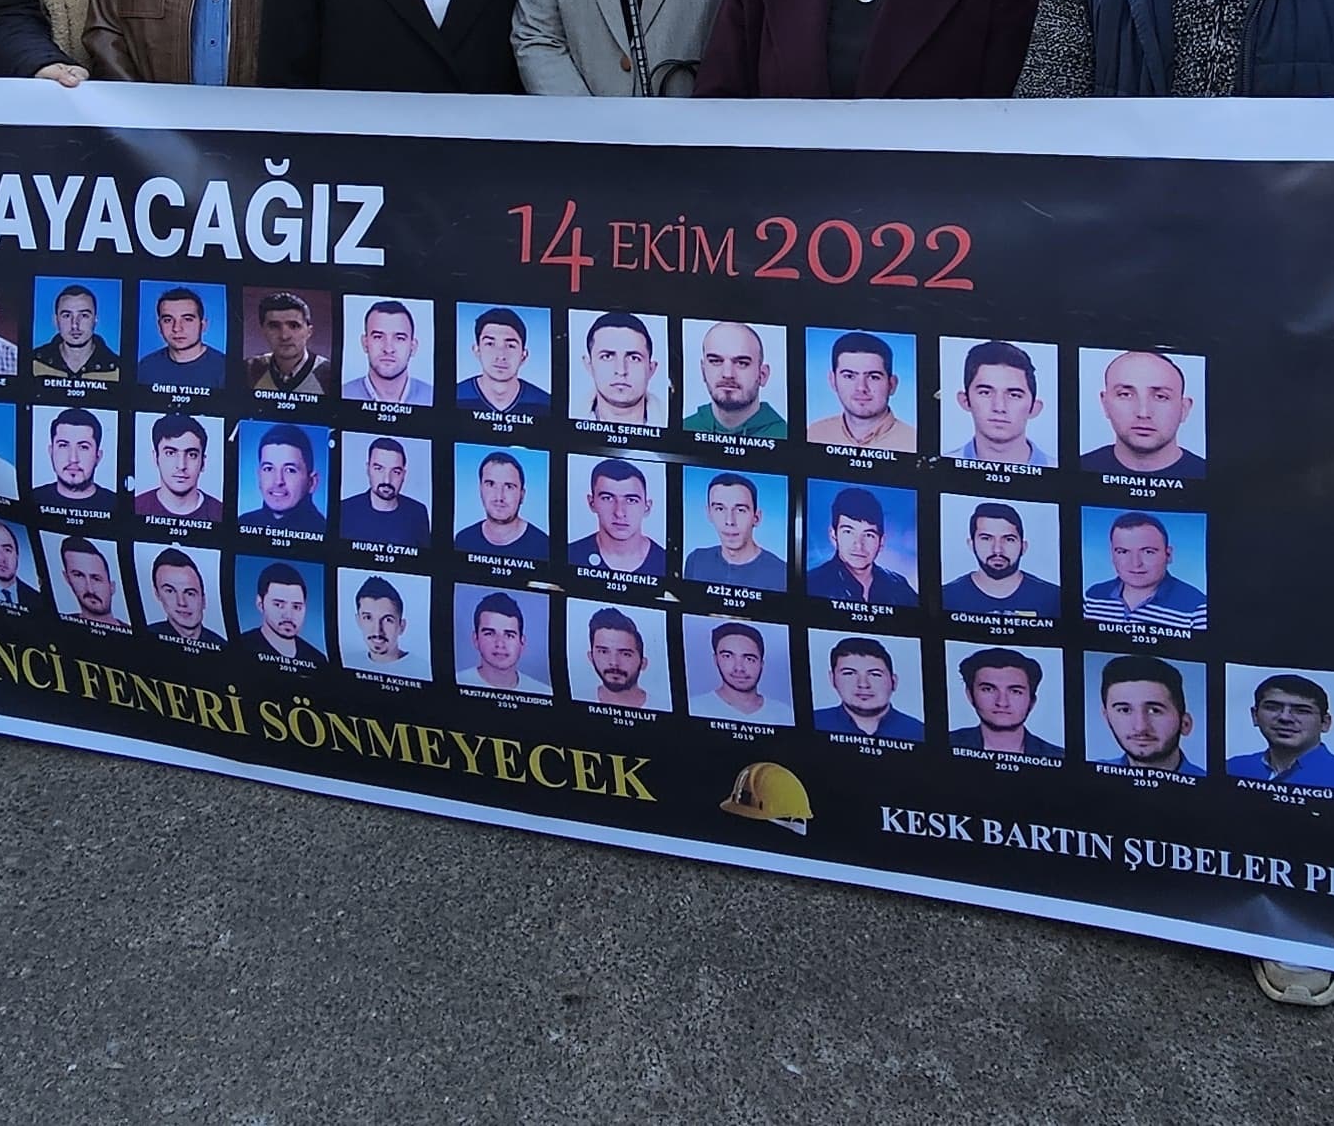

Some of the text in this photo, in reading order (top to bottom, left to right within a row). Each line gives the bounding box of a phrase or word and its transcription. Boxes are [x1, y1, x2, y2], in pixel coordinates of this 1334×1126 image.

[508, 200, 974, 293] 14 EKİM 2022
[44, 378, 108, 391] DENİZ BAYKAL
[151, 382, 210, 396] ÖNER YILDIZ
[67, 389, 86, 397] 2009
[255, 390, 318, 403] ORHAN ALTUN
[171, 395, 191, 404] 2009
[277, 402, 296, 411] 2009
[362, 402, 412, 415] ALİ DOĞRU
[377, 414, 396, 422] 2019
[472, 410, 534, 425] YASİN ÇELİK
[492, 424, 513, 433] 2019
[575, 420, 661, 438] GÜRDAL SERENLİ
[607, 435, 628, 445] 2019
[694, 433, 775, 450] SERKAN NAKAŞ
[723, 446, 746, 456] 2019
[826, 445, 898, 461] OKAN AKGÜL
[849, 459, 873, 469] 2019
[954, 458, 1042, 476] BERKAY KESİM
[985, 473, 1011, 483] 2019
[1102, 474, 1183, 490] EMRAH KAYA
[1129, 487, 1156, 498] 2019
[40, 505, 67, 516] ŞABAN
[66, 517, 84, 525] 2019
[179, 519, 213, 530] KANSIZ
[169, 528, 188, 536] 2019
[240, 525, 264, 536] SUAT
[271, 538, 291, 547] 2019
[352, 541, 418, 556] MURAT ÖZTAN
[374, 554, 395, 563] 2019
[468, 554, 535, 570] EMRAH KAVAL
[491, 567, 512, 576] 2019
[577, 567, 659, 586] ERCAN AKDENİZ
[606, 581, 628, 592] 2019
[706, 585, 762, 601] AZİZ KÖSE
[723, 598, 746, 608] 2019
[831, 600, 894, 616] TANER ŞEN
[851, 613, 875, 623] 2019
[951, 612, 1054, 628] GÖKHAN MERCAN
[989, 626, 1015, 635] 2019
[1098, 622, 1192, 639] BURÇİN SABAN
[1131, 635, 1158, 645] 2019
[279, 665, 297, 673] 2019
[292, 658, 317, 669] OKUL
[497, 701, 518, 709] 2019
[588, 705, 657, 722] RASİM BULUT
[613, 718, 634, 727] 2019
[710, 721, 775, 735] ENES AYDIN
[75, 658, 251, 736] FENERİ
[259, 695, 658, 802] SÖNMEYECEK
[732, 732, 754, 741] 2019
[830, 734, 915, 751] MEHMET BULUT
[859, 746, 883, 756] 2019
[953, 747, 1062, 768] BERKAY PINAROĞLU
[995, 762, 1020, 772] 2019
[1096, 764, 1196, 786] FERHAN POYRAZ
[1133, 778, 1159, 788] 2019
[1237, 779, 1288, 794] AYHAN
[1272, 793, 1306, 806] 2012
[880, 806, 974, 842] KESK
[981, 818, 1114, 862] BARTIN
[1123, 837, 1295, 889] ŞUBELER
